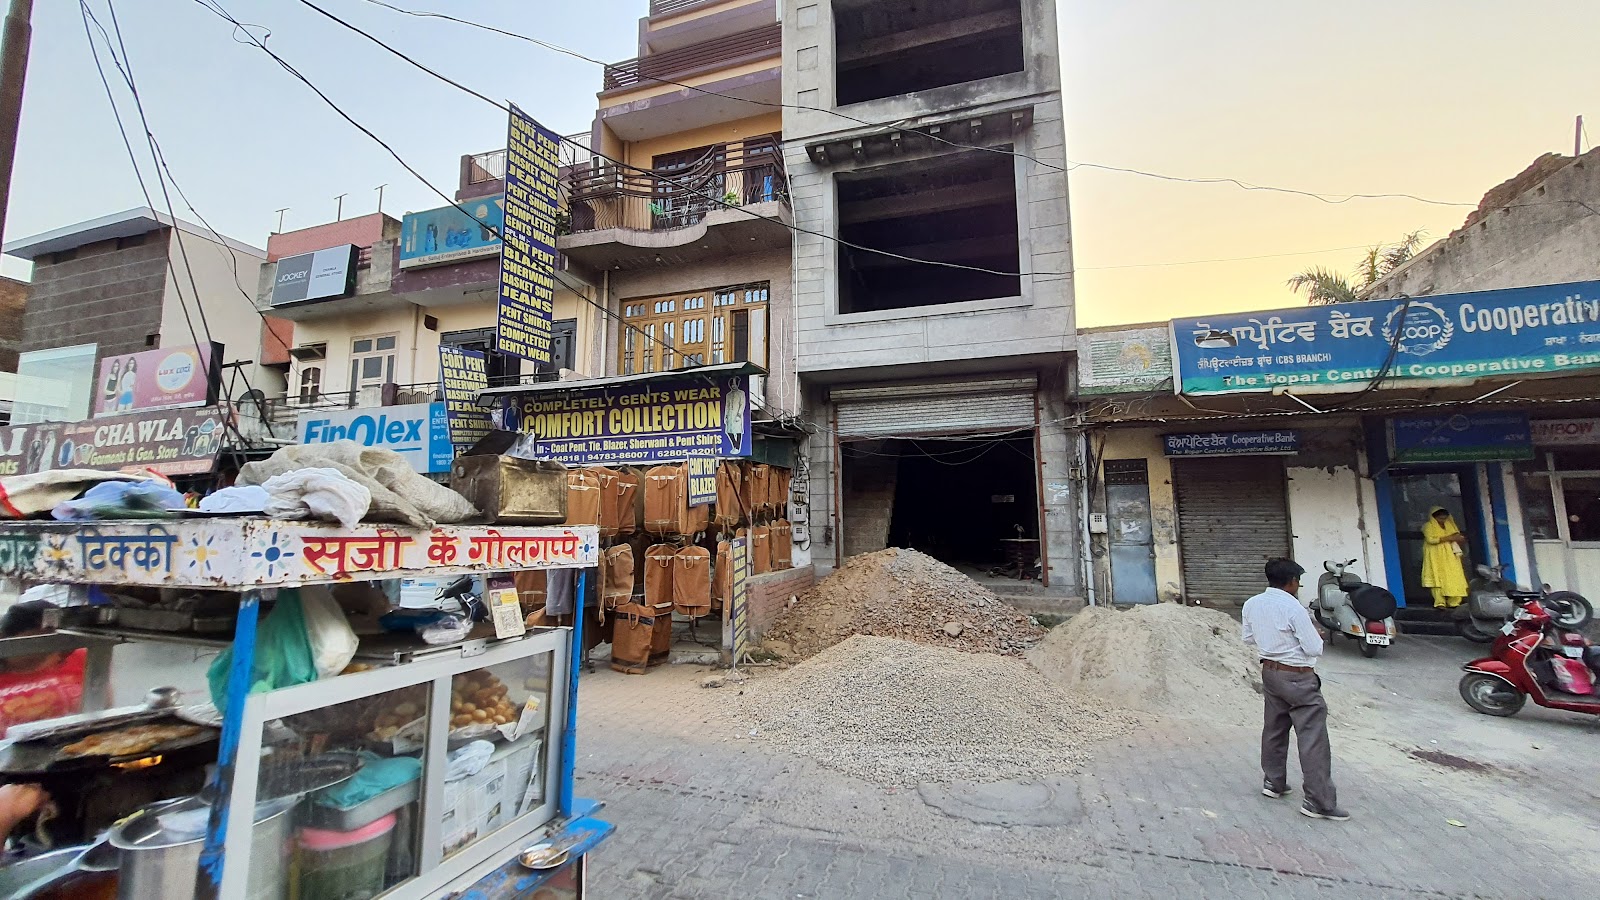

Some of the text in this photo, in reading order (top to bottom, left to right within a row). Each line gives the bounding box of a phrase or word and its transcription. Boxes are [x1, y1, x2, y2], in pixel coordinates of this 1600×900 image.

[511, 114, 536, 138] COAT
[537, 132, 559, 153] PENT
[511, 126, 559, 165] BLAZER
[509, 151, 558, 188] BASKET SUIT
[510, 138, 558, 178] SHERWANI
[508, 164, 557, 200] JEANS
[508, 182, 557, 217] PENT SHIRTS
[505, 214, 556, 248] GENTS WEAR
[506, 202, 555, 235] COMPLETELY
[532, 247, 554, 265] PENT
[278, 270, 308, 282] JOCKEY
[503, 260, 553, 289] SHERWANI
[503, 271, 553, 301] BASKET SUIT
[502, 286, 552, 313] JEANS
[500, 317, 551, 339] COMFORT COLLECTION
[501, 304, 551, 331] PENT SHIRTS
[1328, 310, 1374, 339] ਬੈਂਕ
[499, 337, 550, 363] GENTS WEAR
[500, 325, 550, 350] COMPLETELY
[442, 352, 485, 373] COAT PENT
[1264, 370, 1321, 387] Ropar
[1409, 357, 1545, 377] Cooperative
[1276, 355, 1294, 366] (CBS
[1296, 353, 1332, 364] BRANCH)
[443, 368, 488, 383] BLAZER
[446, 389, 473, 401] BASKET
[524, 396, 615, 413] COMPLETELY
[620, 391, 670, 405] GENTS
[674, 387, 721, 401] WEAR
[94, 417, 183, 447] CHAWLA
[450, 418, 467, 429] PENT
[524, 400, 720, 439] COMFORT COLLECTION
[551, 443, 568, 453] Coat
[569, 441, 588, 452] Pent,
[603, 439, 628, 451] Blazer,
[630, 436, 667, 449] Sherwani
[668, 438, 675, 447] &
[676, 435, 695, 446] Pent
[696, 434, 722, 446] Shirts
[1232, 432, 1274, 446] Cooperative
[1275, 431, 1296, 443] Bank
[90, 450, 126, 465] Garments
[126, 447, 134, 461] &
[136, 446, 154, 462] Gen.
[156, 445, 179, 460] Store
[588, 451, 649, 460] 94783-86007
[690, 458, 703, 475] COAT
[691, 477, 716, 496] BLAZER
[76, 524, 179, 573] टिक्की
[427, 528, 461, 565] के
[469, 529, 579, 567] गोलगप्पे
